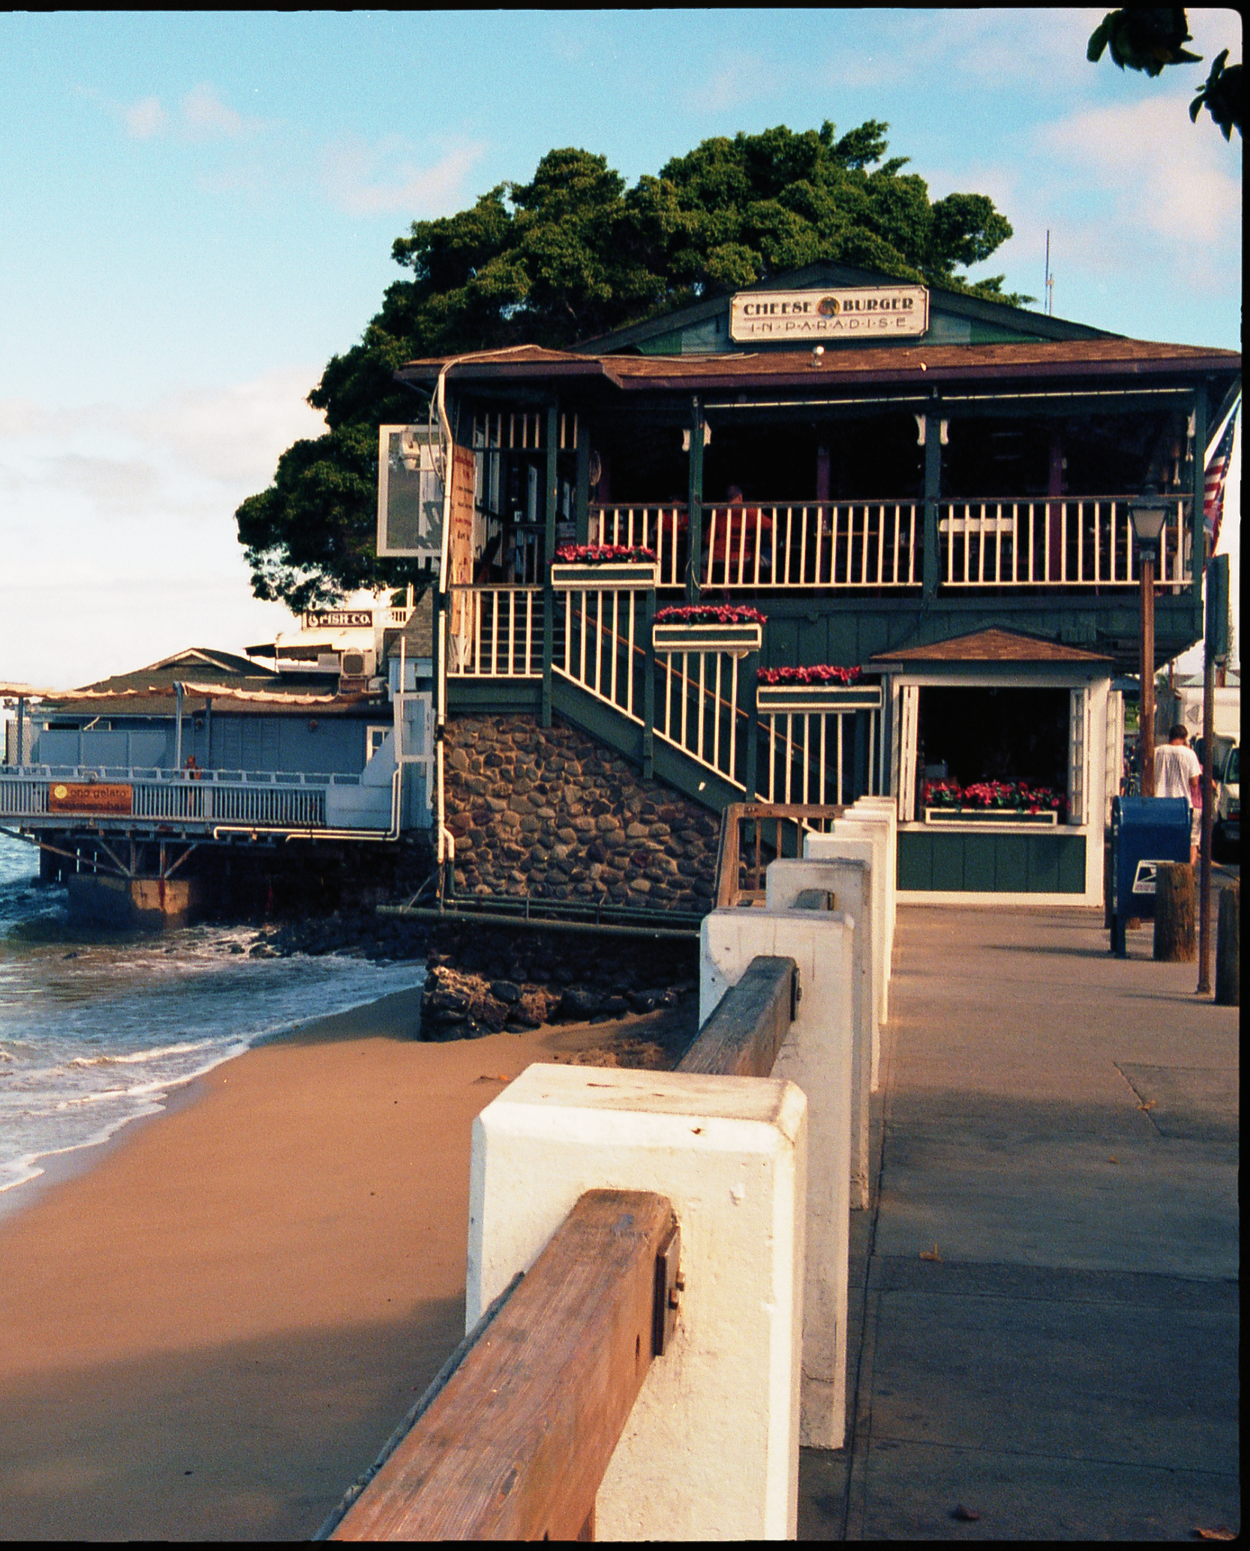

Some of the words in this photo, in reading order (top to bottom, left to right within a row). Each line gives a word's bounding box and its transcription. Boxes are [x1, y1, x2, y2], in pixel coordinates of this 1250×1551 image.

[743, 301, 812, 316] CHEESE
[842, 297, 914, 312] BURGER
[70, 789, 90, 797] ono
[93, 788, 126, 799] gelato
